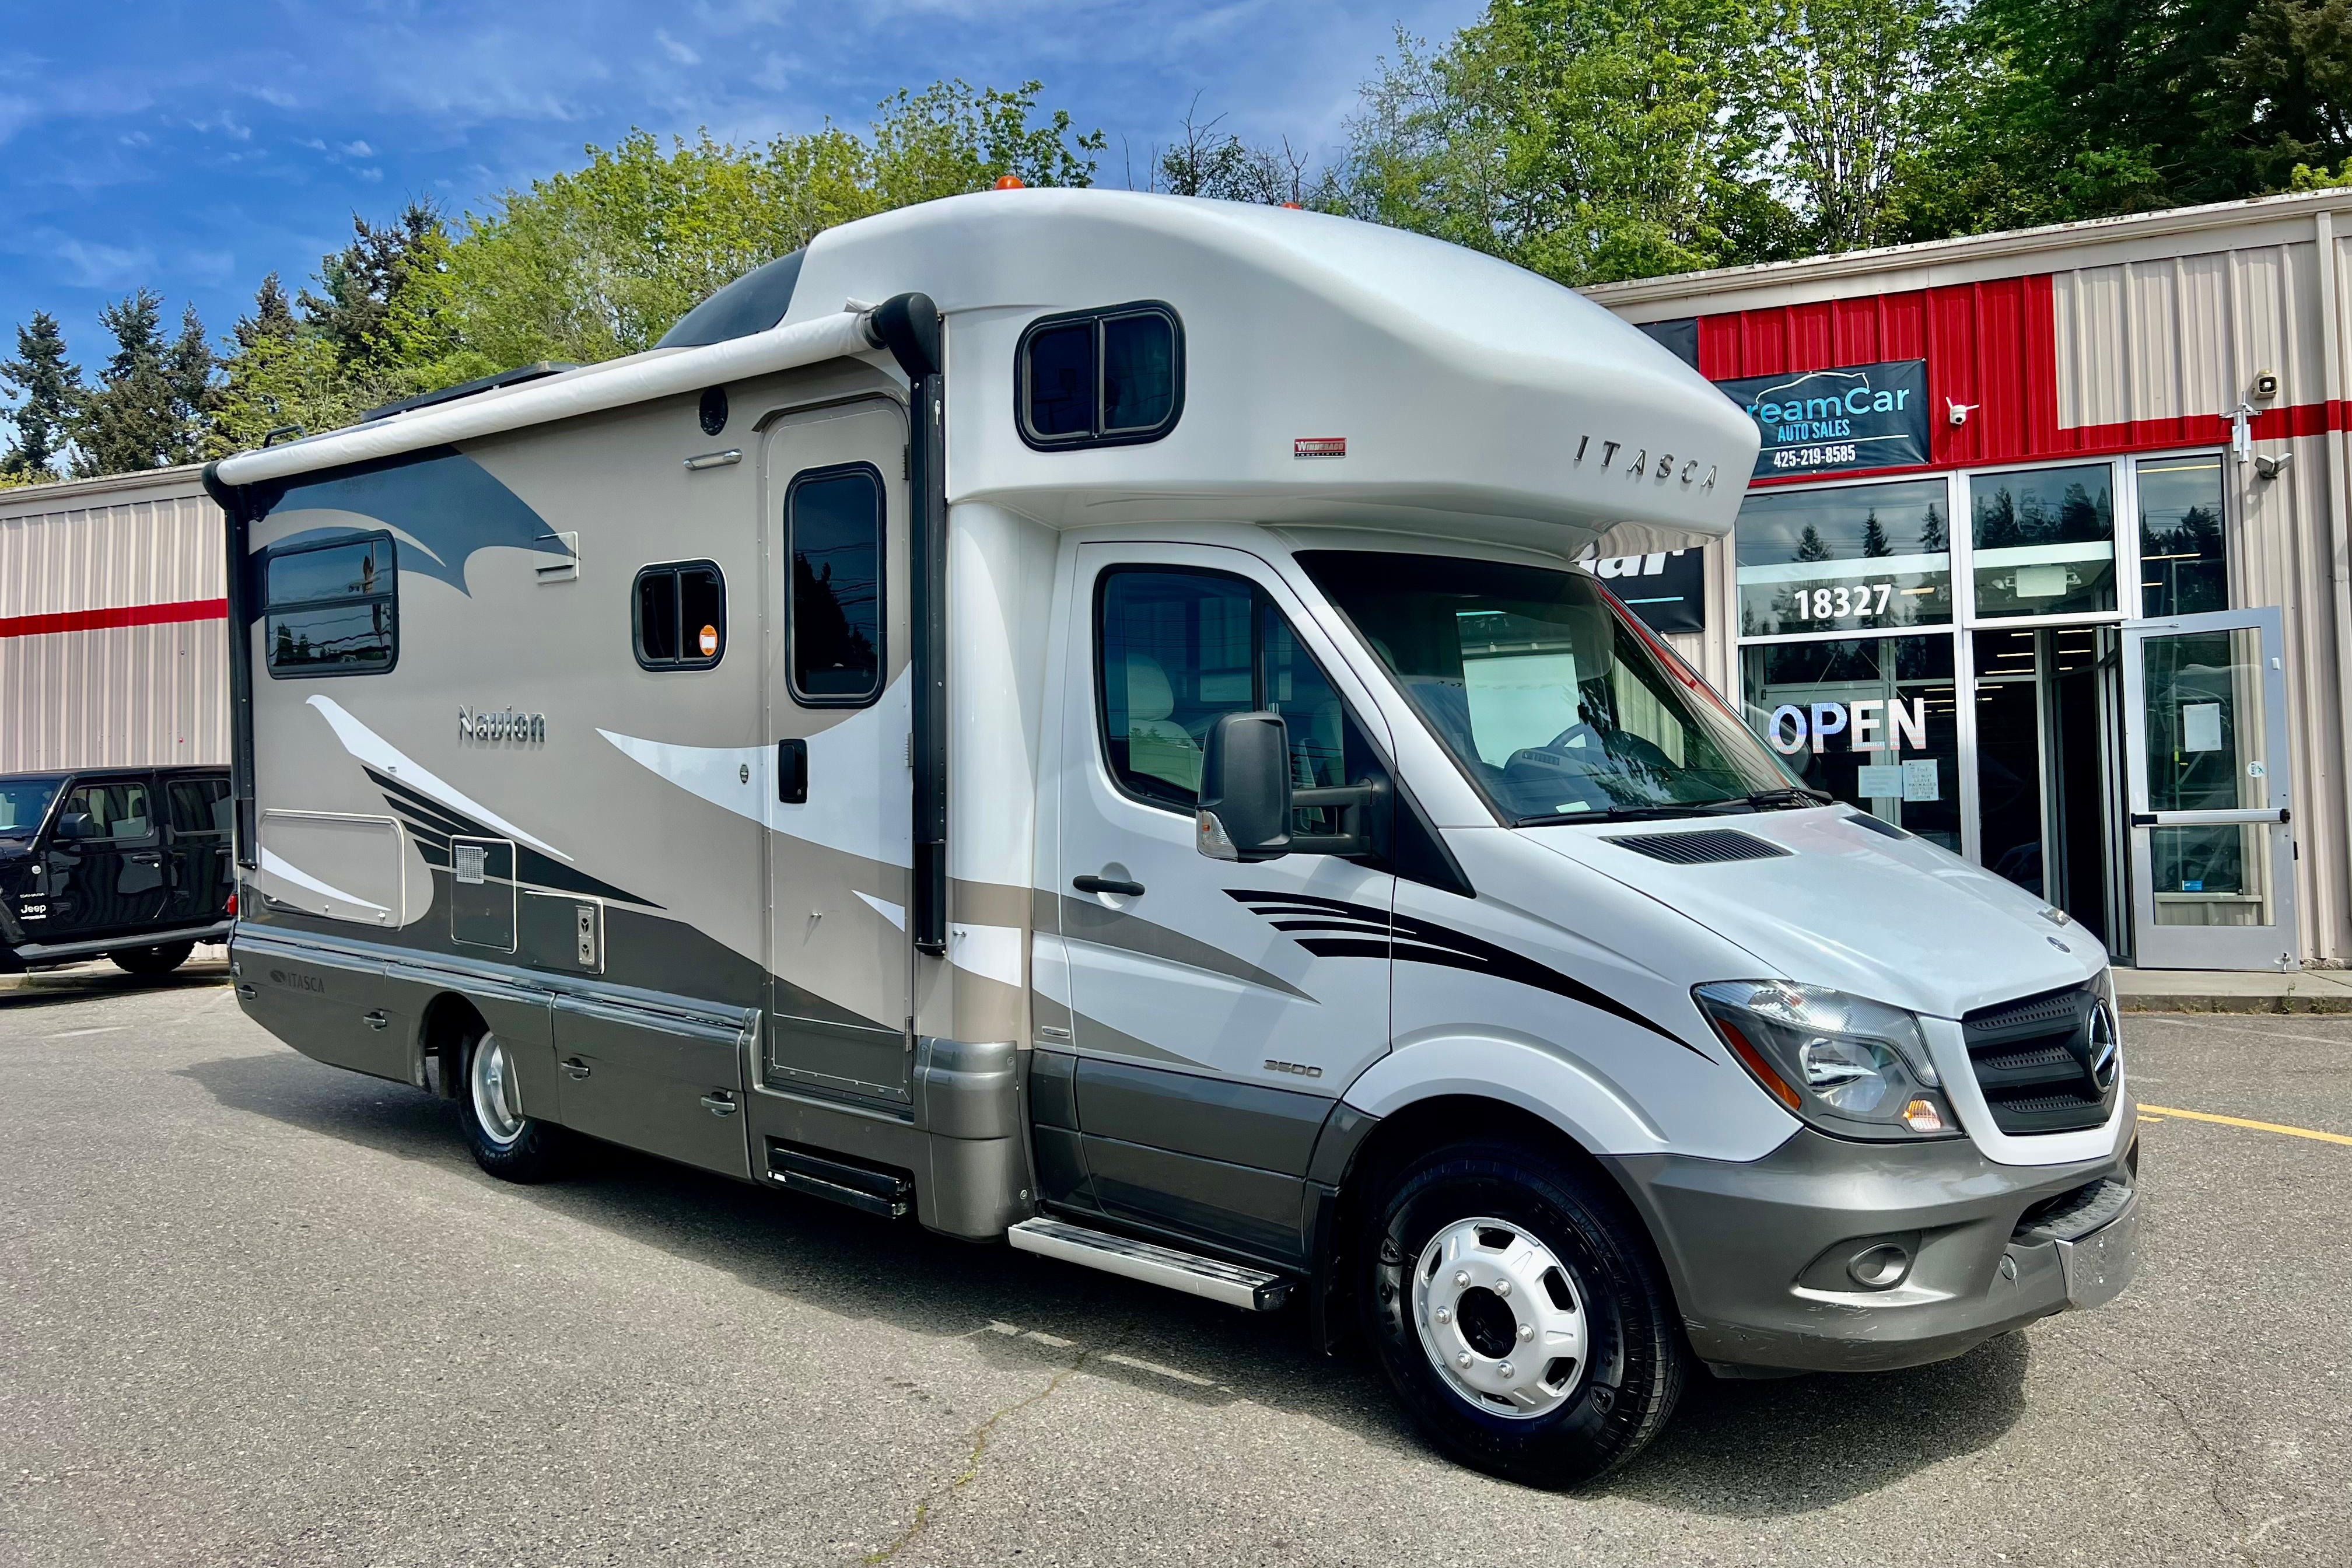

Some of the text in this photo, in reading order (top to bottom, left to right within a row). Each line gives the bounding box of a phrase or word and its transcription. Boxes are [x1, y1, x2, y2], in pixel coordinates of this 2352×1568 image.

[1746, 387, 1909, 424] reamCar
[1777, 419, 1850, 442] AUTO SALES
[1574, 435, 1717, 488] ITASCA
[1773, 444, 1856, 468] 425-219-8585
[1794, 583, 1891, 620] 18327
[459, 704, 546, 742] Navion
[1769, 698, 1926, 755] OPEN
[20, 904, 46, 914] Jeep
[288, 972, 325, 994] ITASCA
